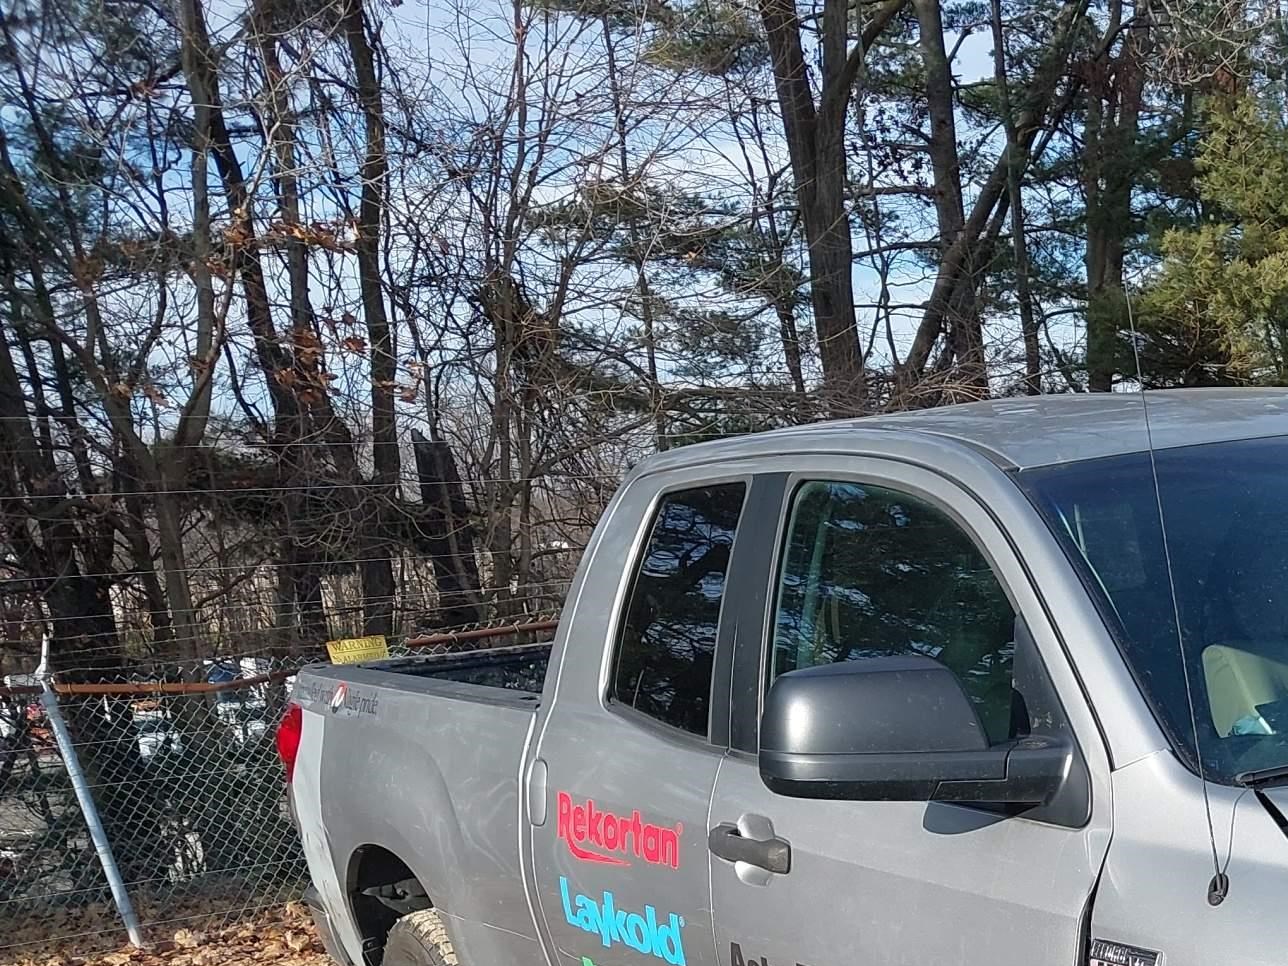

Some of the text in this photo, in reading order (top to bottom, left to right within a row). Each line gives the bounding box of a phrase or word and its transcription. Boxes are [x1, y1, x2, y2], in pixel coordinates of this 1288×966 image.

[332, 638, 383, 652] WARNING
[557, 792, 681, 869] Rekortan
[559, 876, 686, 966] Laykold
